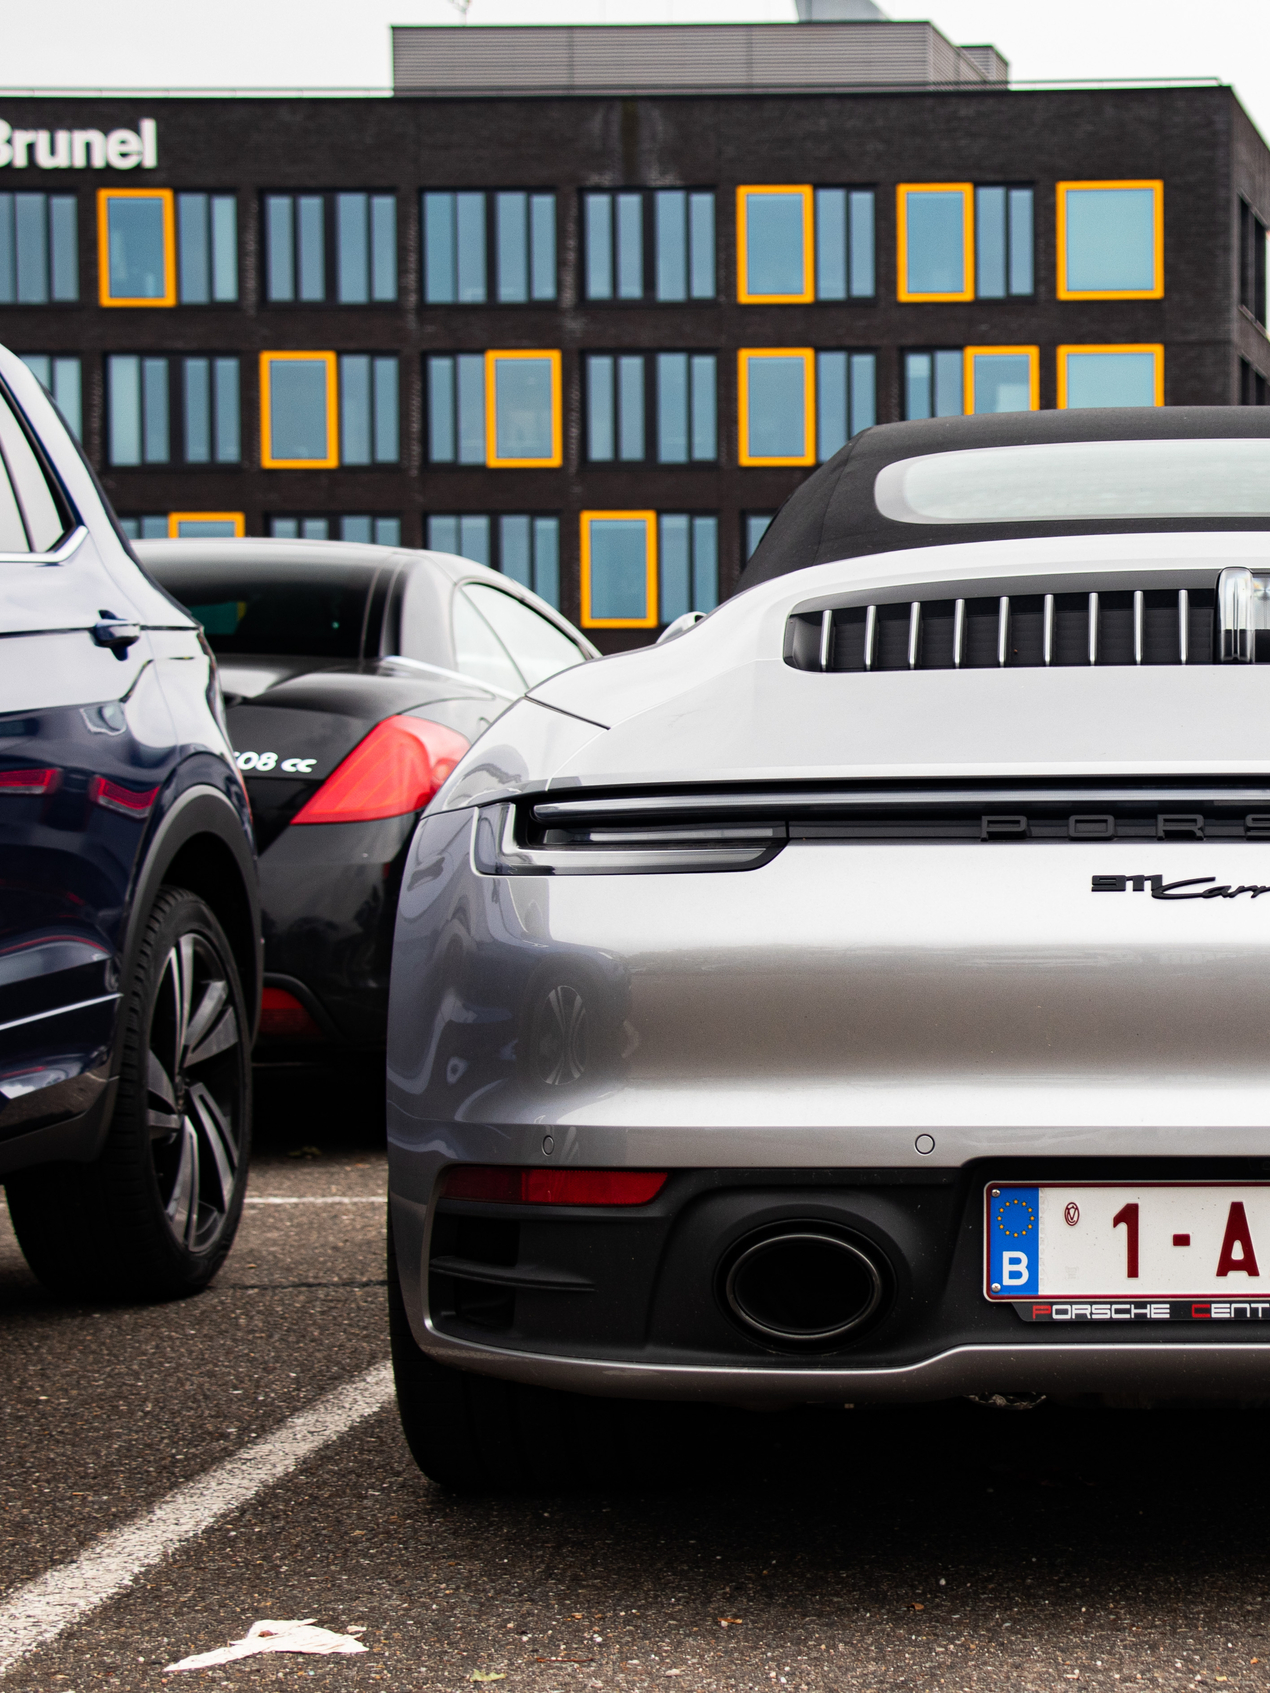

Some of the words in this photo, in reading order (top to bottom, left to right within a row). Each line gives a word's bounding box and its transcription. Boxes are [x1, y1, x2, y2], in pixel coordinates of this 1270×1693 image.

[233, 751, 278, 771] 08
[1091, 874, 1163, 892] 911
[1002, 1251, 1030, 1286] B
[1032, 1304, 1170, 1320] PORSCHE
